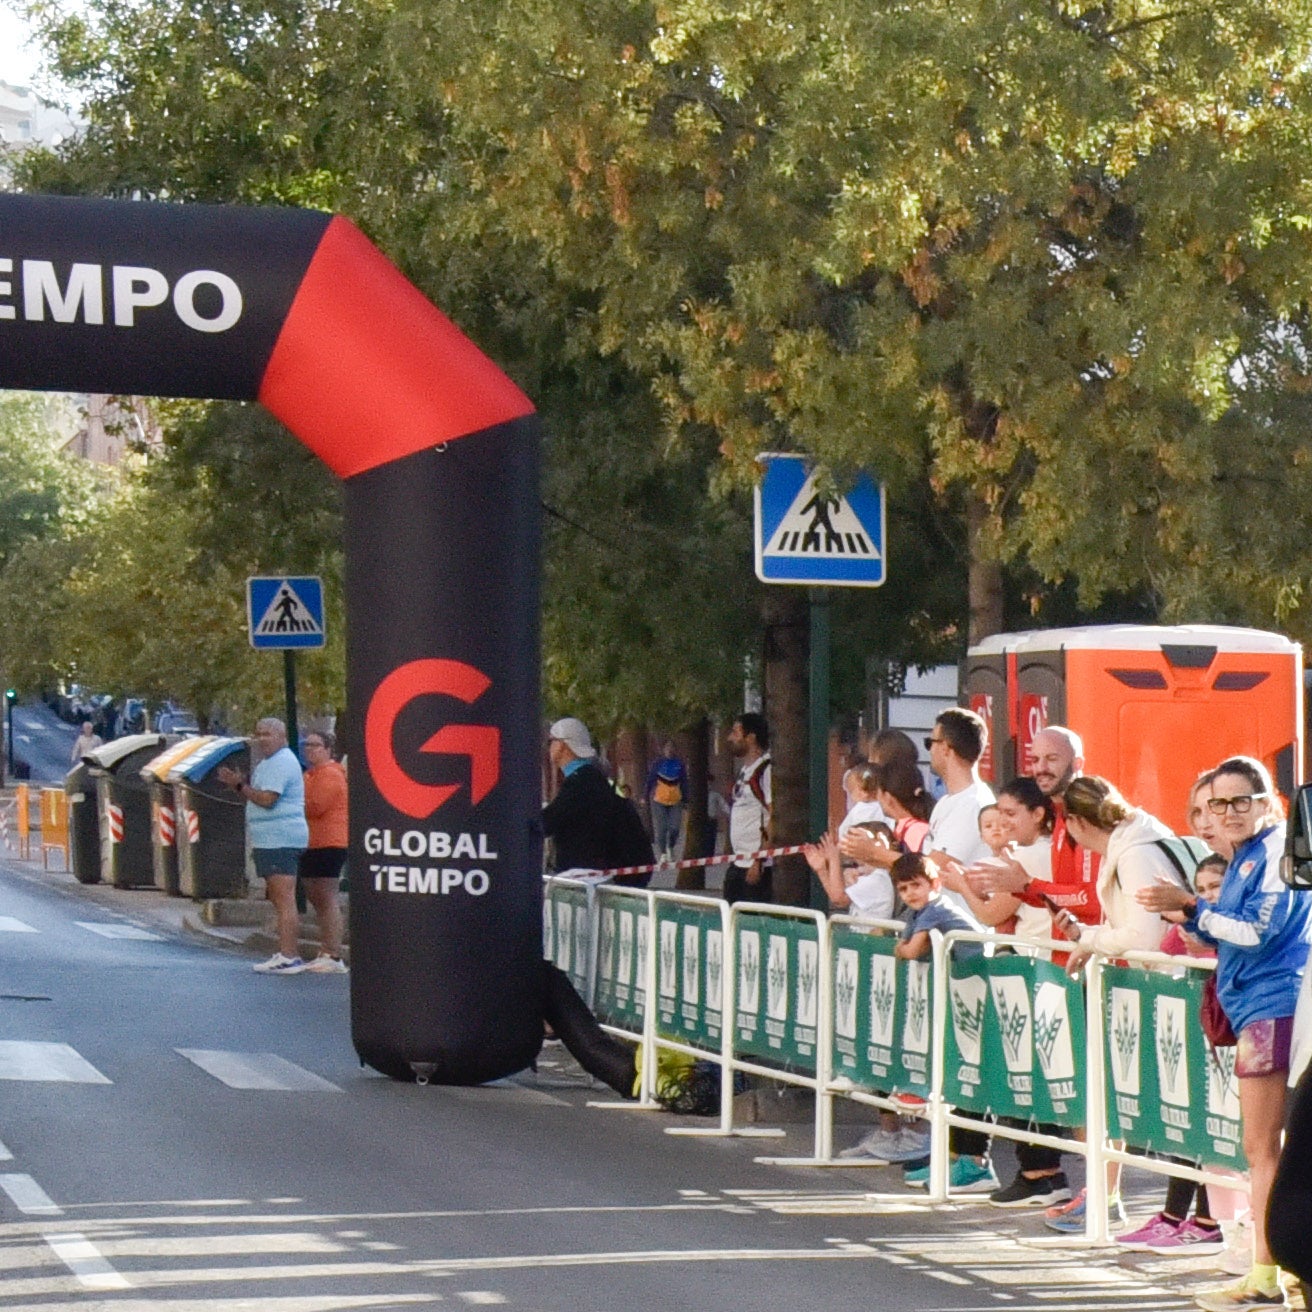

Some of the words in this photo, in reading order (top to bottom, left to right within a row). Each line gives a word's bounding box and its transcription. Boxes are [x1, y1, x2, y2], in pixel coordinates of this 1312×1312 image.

[0, 257, 243, 333] MPO
[364, 827, 499, 860] GLOBAL
[369, 864, 491, 897] TEMPO
